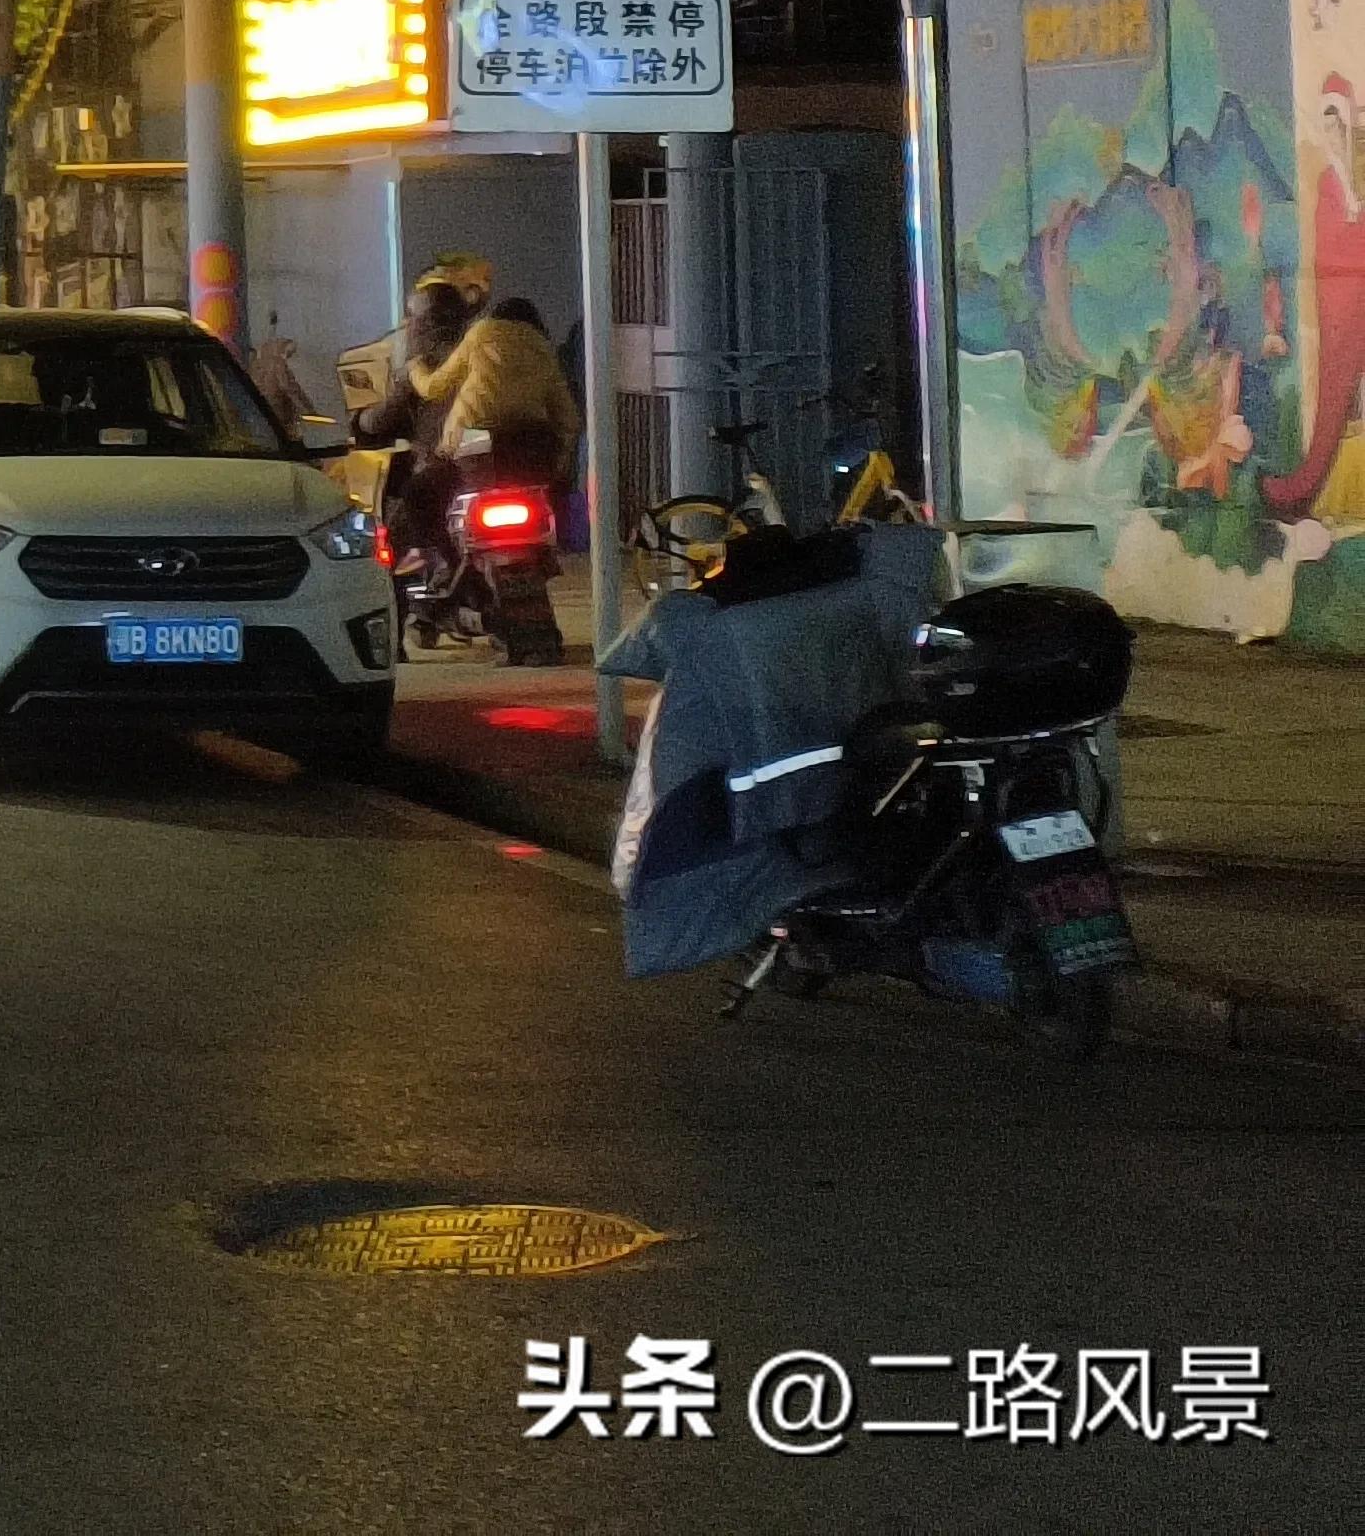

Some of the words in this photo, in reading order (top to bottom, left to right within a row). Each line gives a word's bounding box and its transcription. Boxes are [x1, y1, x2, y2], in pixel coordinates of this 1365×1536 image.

[481, 1, 705, 38] 全路段禁停
[476, 47, 706, 84] 停车泊位除外
